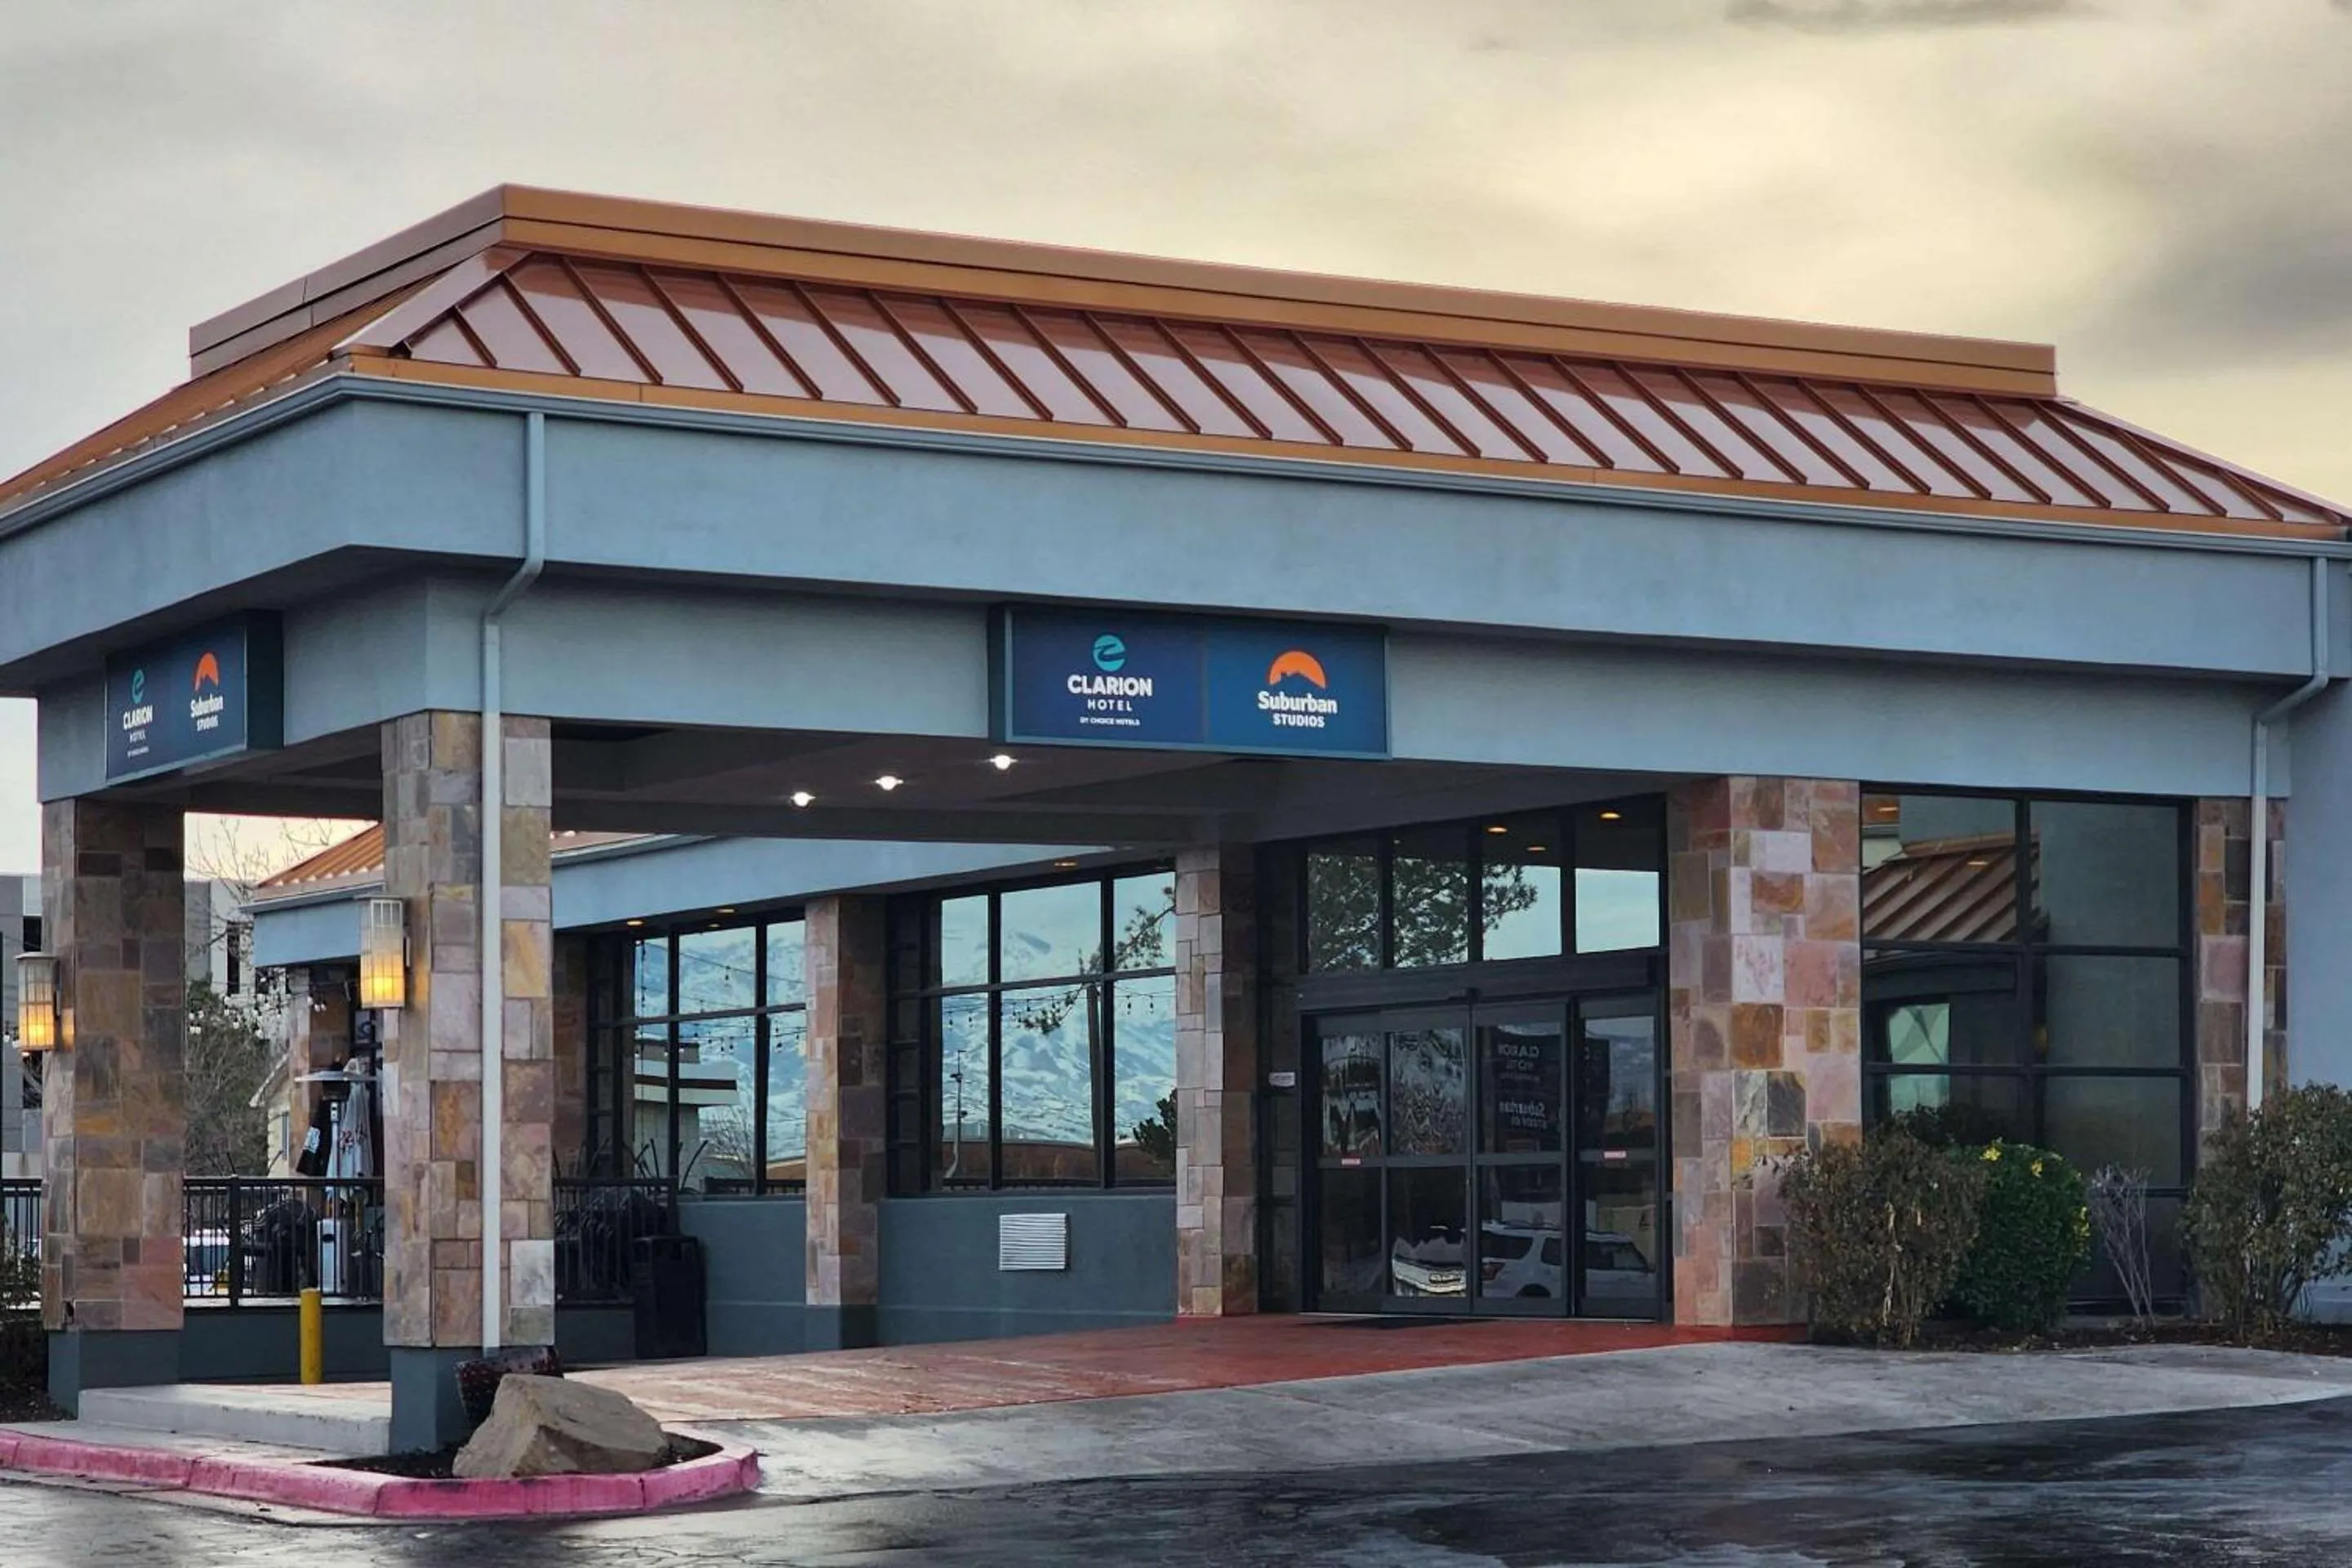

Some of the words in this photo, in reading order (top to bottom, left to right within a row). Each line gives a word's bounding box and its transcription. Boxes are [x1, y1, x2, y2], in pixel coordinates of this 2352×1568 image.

[1067, 674, 1153, 697] CLARION
[1087, 698, 1133, 712] HOTEL
[1258, 690, 1338, 714] Suburban
[123, 705, 154, 731] CLARION
[1272, 712, 1325, 728] STUDIOS
